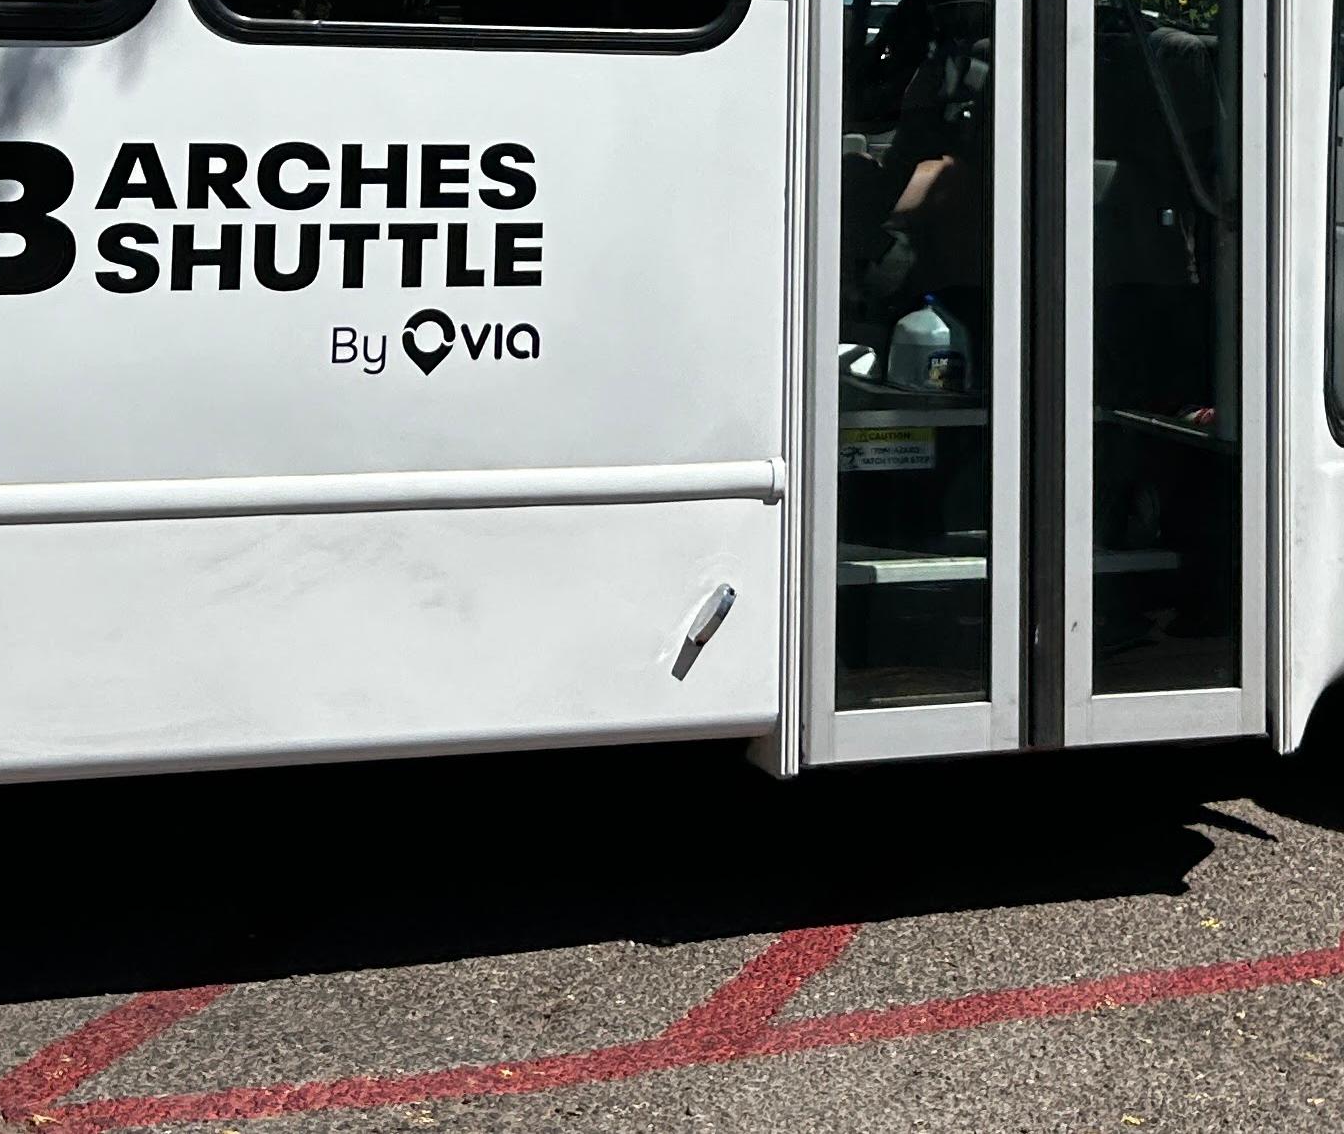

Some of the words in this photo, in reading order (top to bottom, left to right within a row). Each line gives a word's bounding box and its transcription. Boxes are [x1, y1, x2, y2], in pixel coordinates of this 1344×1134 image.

[95, 141, 537, 211] ARCHES
[95, 222, 543, 294] SHUTTLE
[331, 327, 387, 375] By
[460, 322, 541, 361] via
[868, 431, 911, 441] CAUTION
